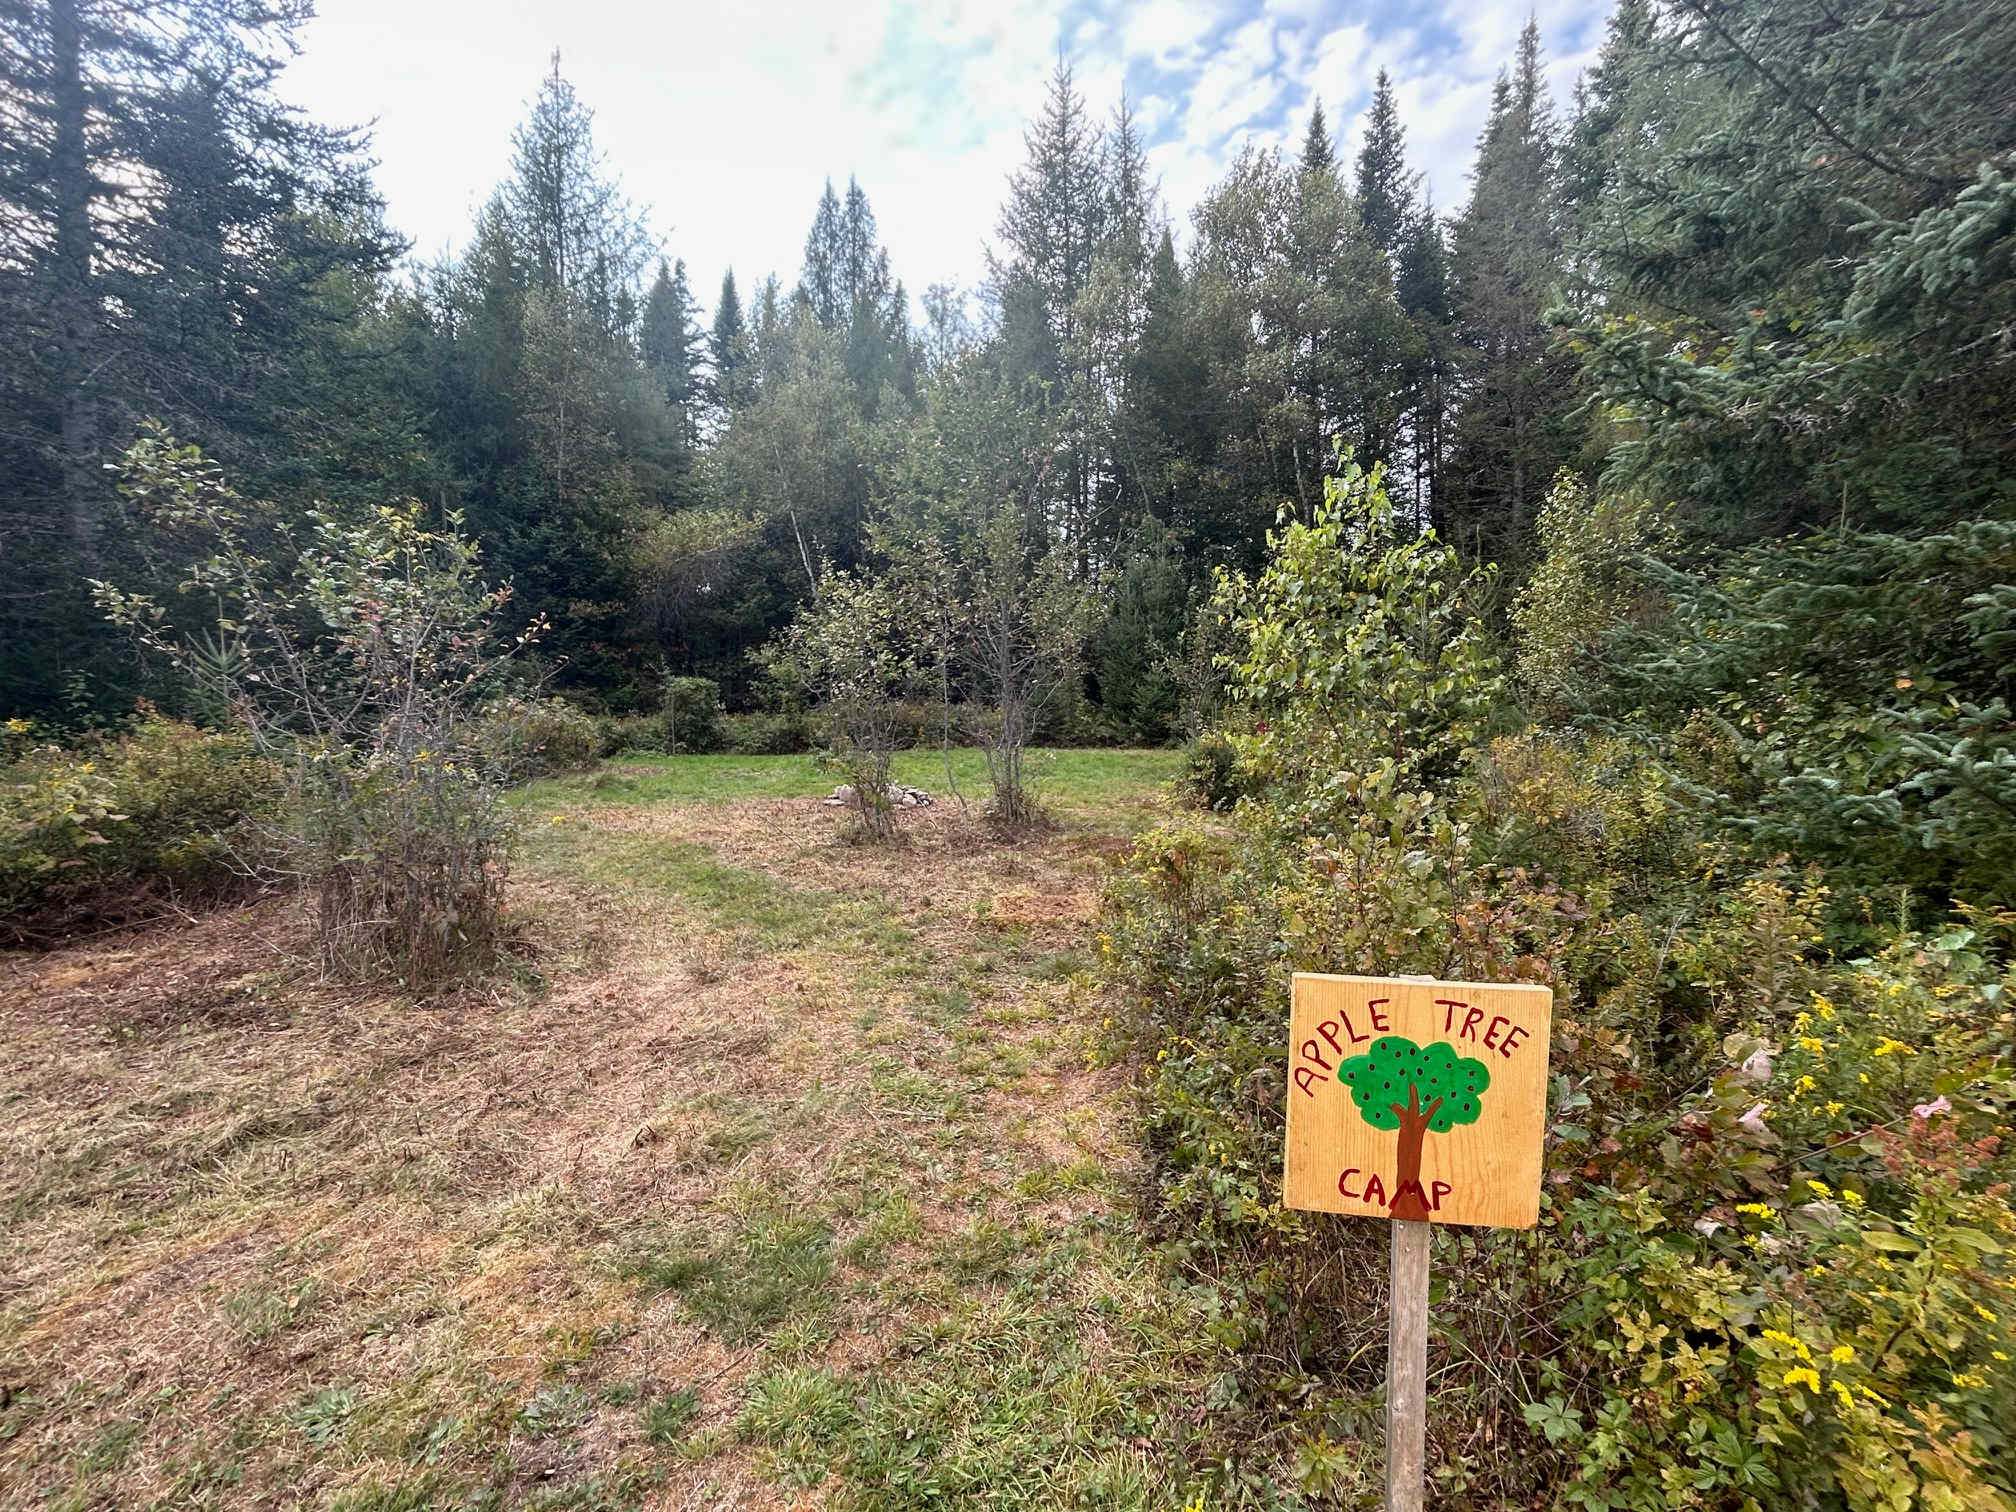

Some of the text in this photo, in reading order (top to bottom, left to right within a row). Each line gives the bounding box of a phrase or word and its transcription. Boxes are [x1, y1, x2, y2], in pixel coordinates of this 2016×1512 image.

[1294, 999, 1530, 1098] APPLE TREE
[1338, 1168, 1452, 1211] CAMP
